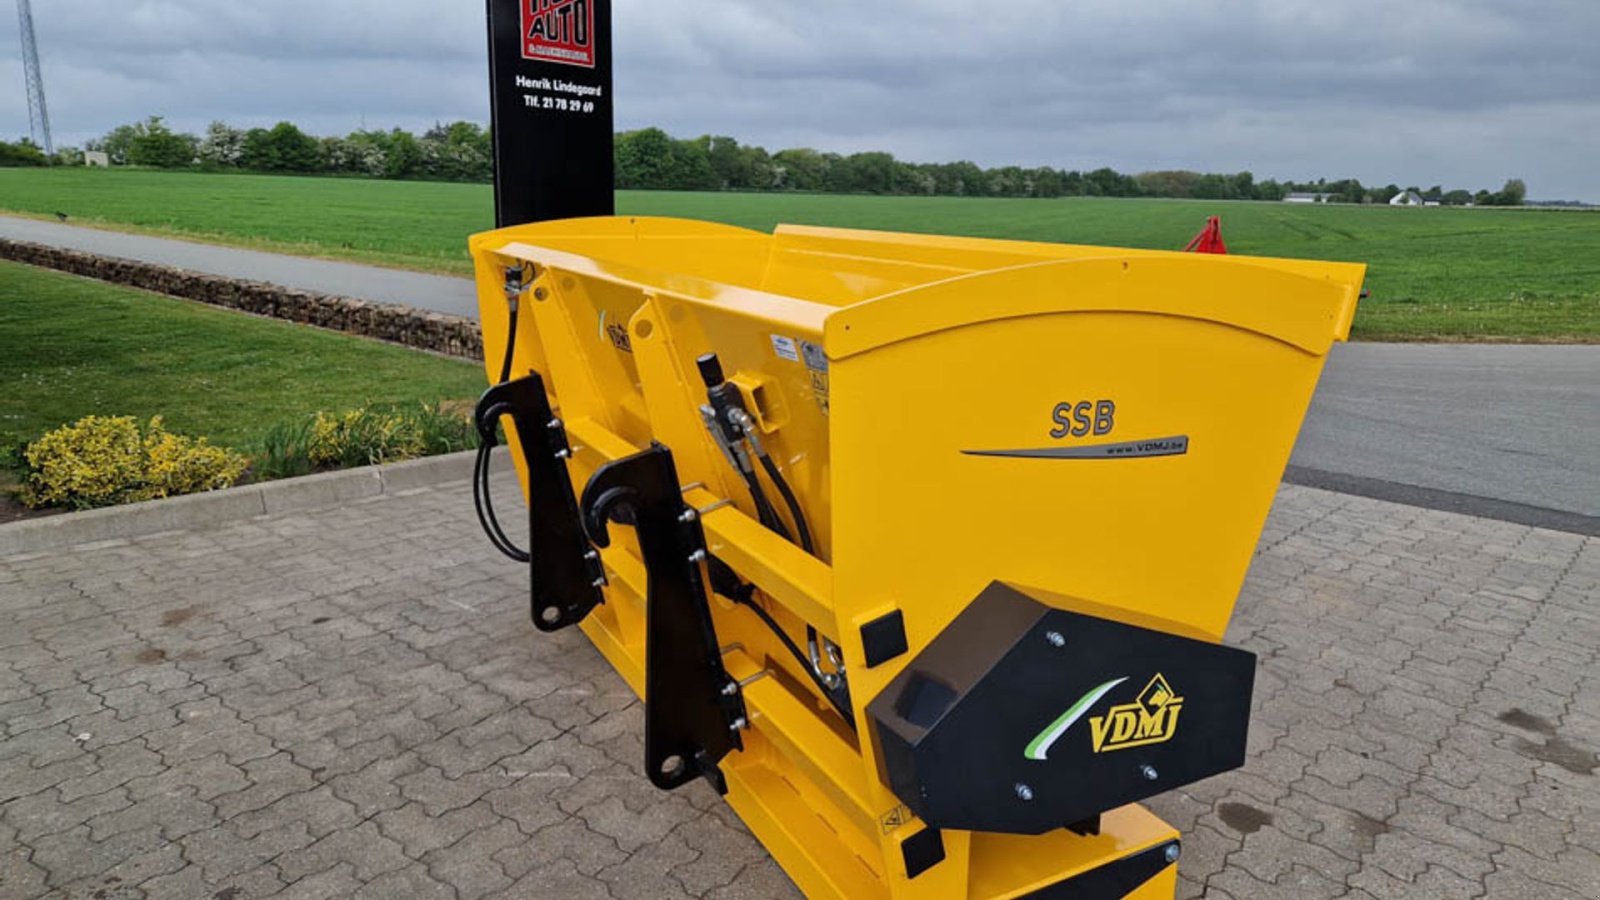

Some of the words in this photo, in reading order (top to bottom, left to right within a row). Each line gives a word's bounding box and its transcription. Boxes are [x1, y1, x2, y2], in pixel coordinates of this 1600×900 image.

[527, 0, 590, 47] AUTO
[515, 75, 551, 90] Henrik
[553, 80, 602, 97] Lindegaard
[523, 94, 540, 108] Tlf.
[542, 97, 554, 109] 21
[556, 98, 567, 111] 78
[569, 100, 581, 112] 29
[583, 101, 594, 113] 69
[1050, 400, 1116, 439] SSB
[1089, 697, 1184, 753] VDMJ
